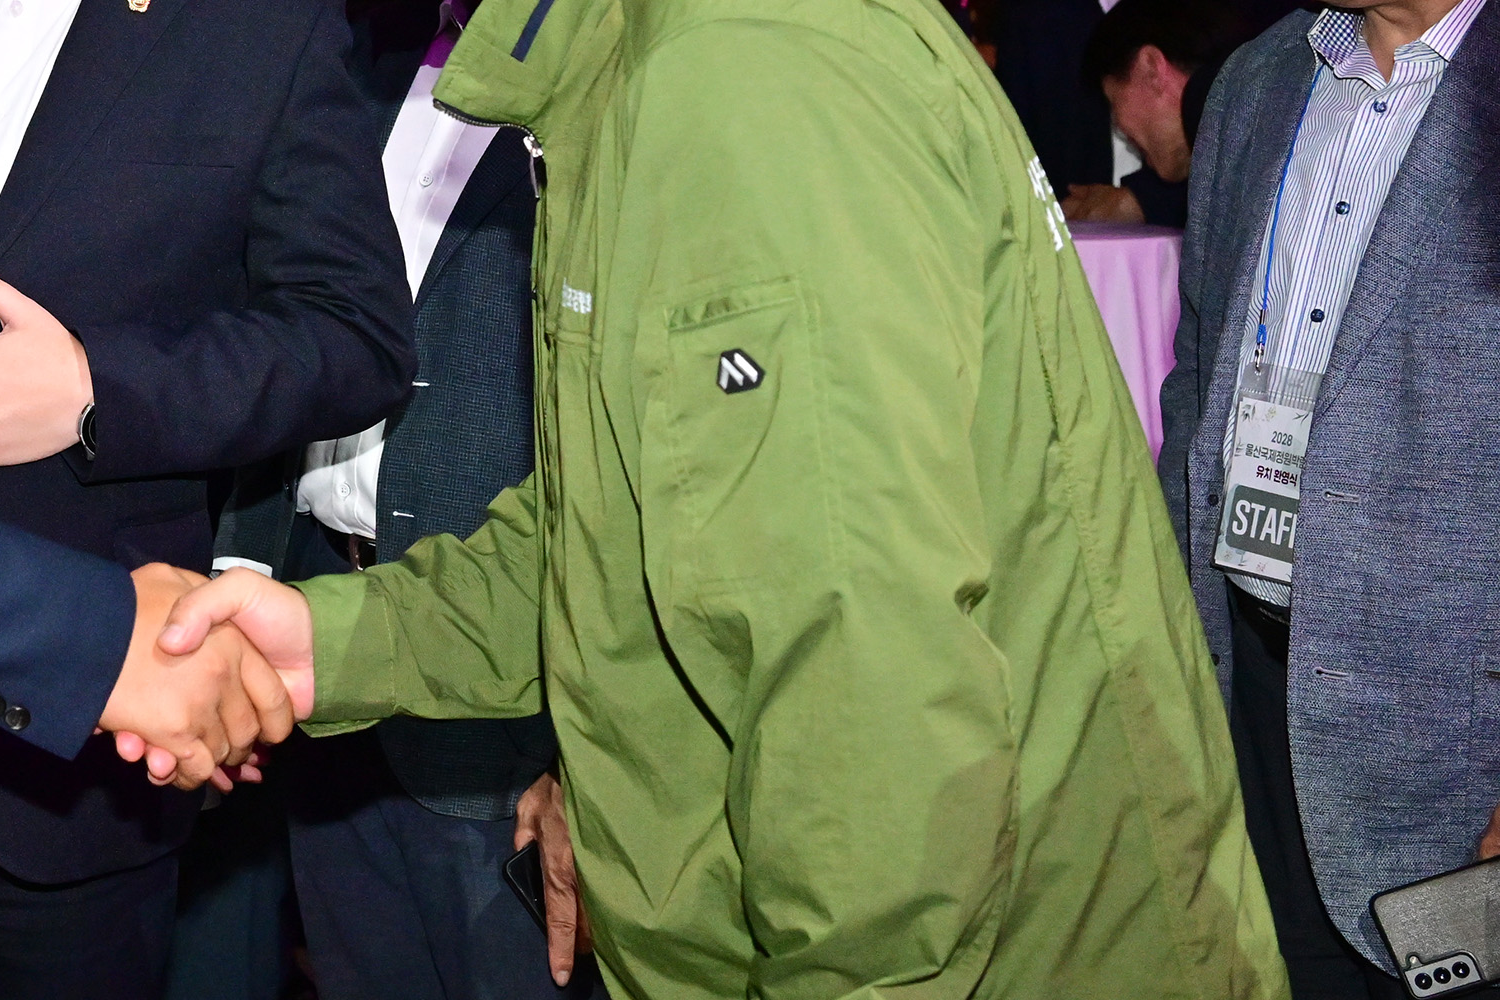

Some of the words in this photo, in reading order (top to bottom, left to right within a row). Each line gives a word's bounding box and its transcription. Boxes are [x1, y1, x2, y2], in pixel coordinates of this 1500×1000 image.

[1271, 430, 1294, 447] 2028
[1256, 465, 1273, 481] 유치
[1273, 469, 1298, 487] 환영식
